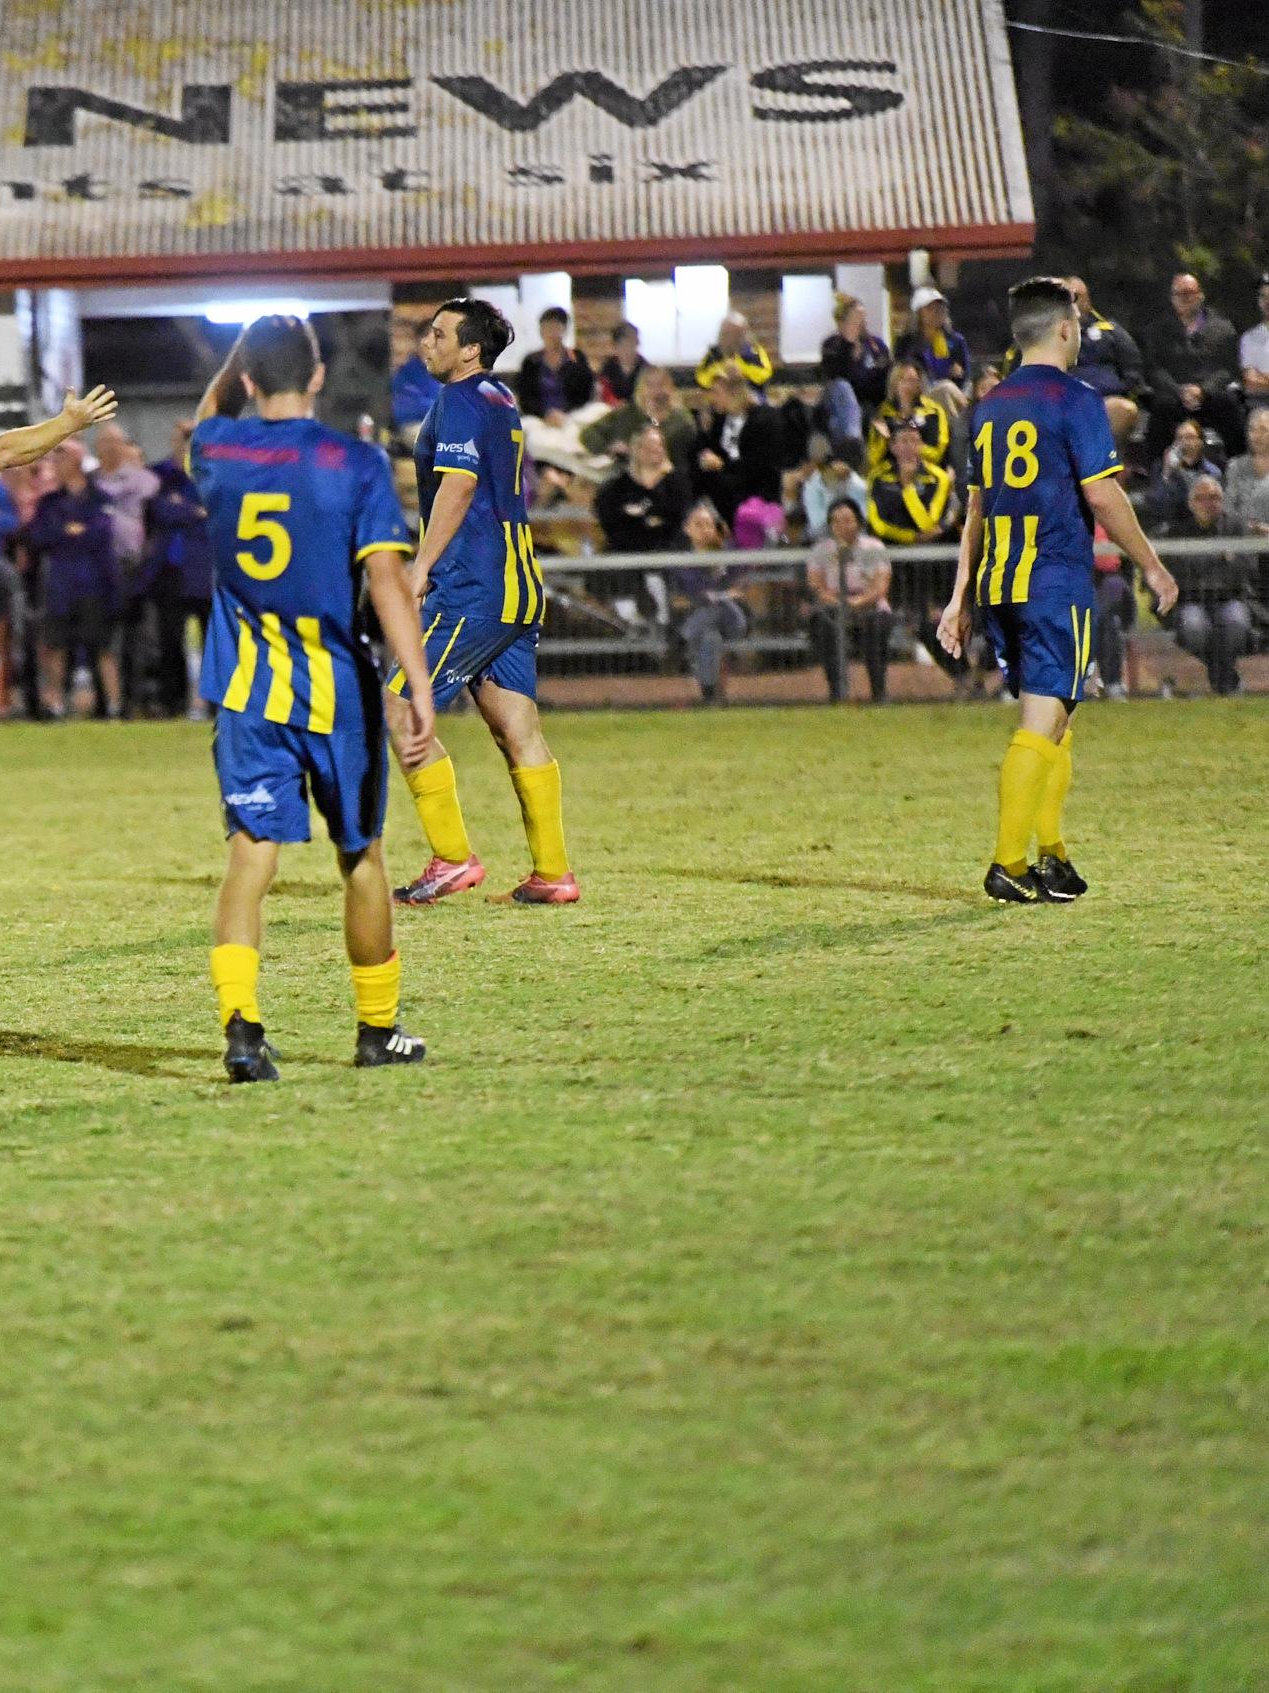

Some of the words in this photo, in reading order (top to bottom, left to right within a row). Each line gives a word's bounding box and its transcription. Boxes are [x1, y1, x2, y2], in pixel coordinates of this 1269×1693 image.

[24, 58, 903, 148] NEWS
[277, 166, 431, 196] at
[507, 153, 719, 188] six
[511, 429, 524, 495] 7
[974, 420, 1039, 489] 18
[236, 493, 292, 580] 5
